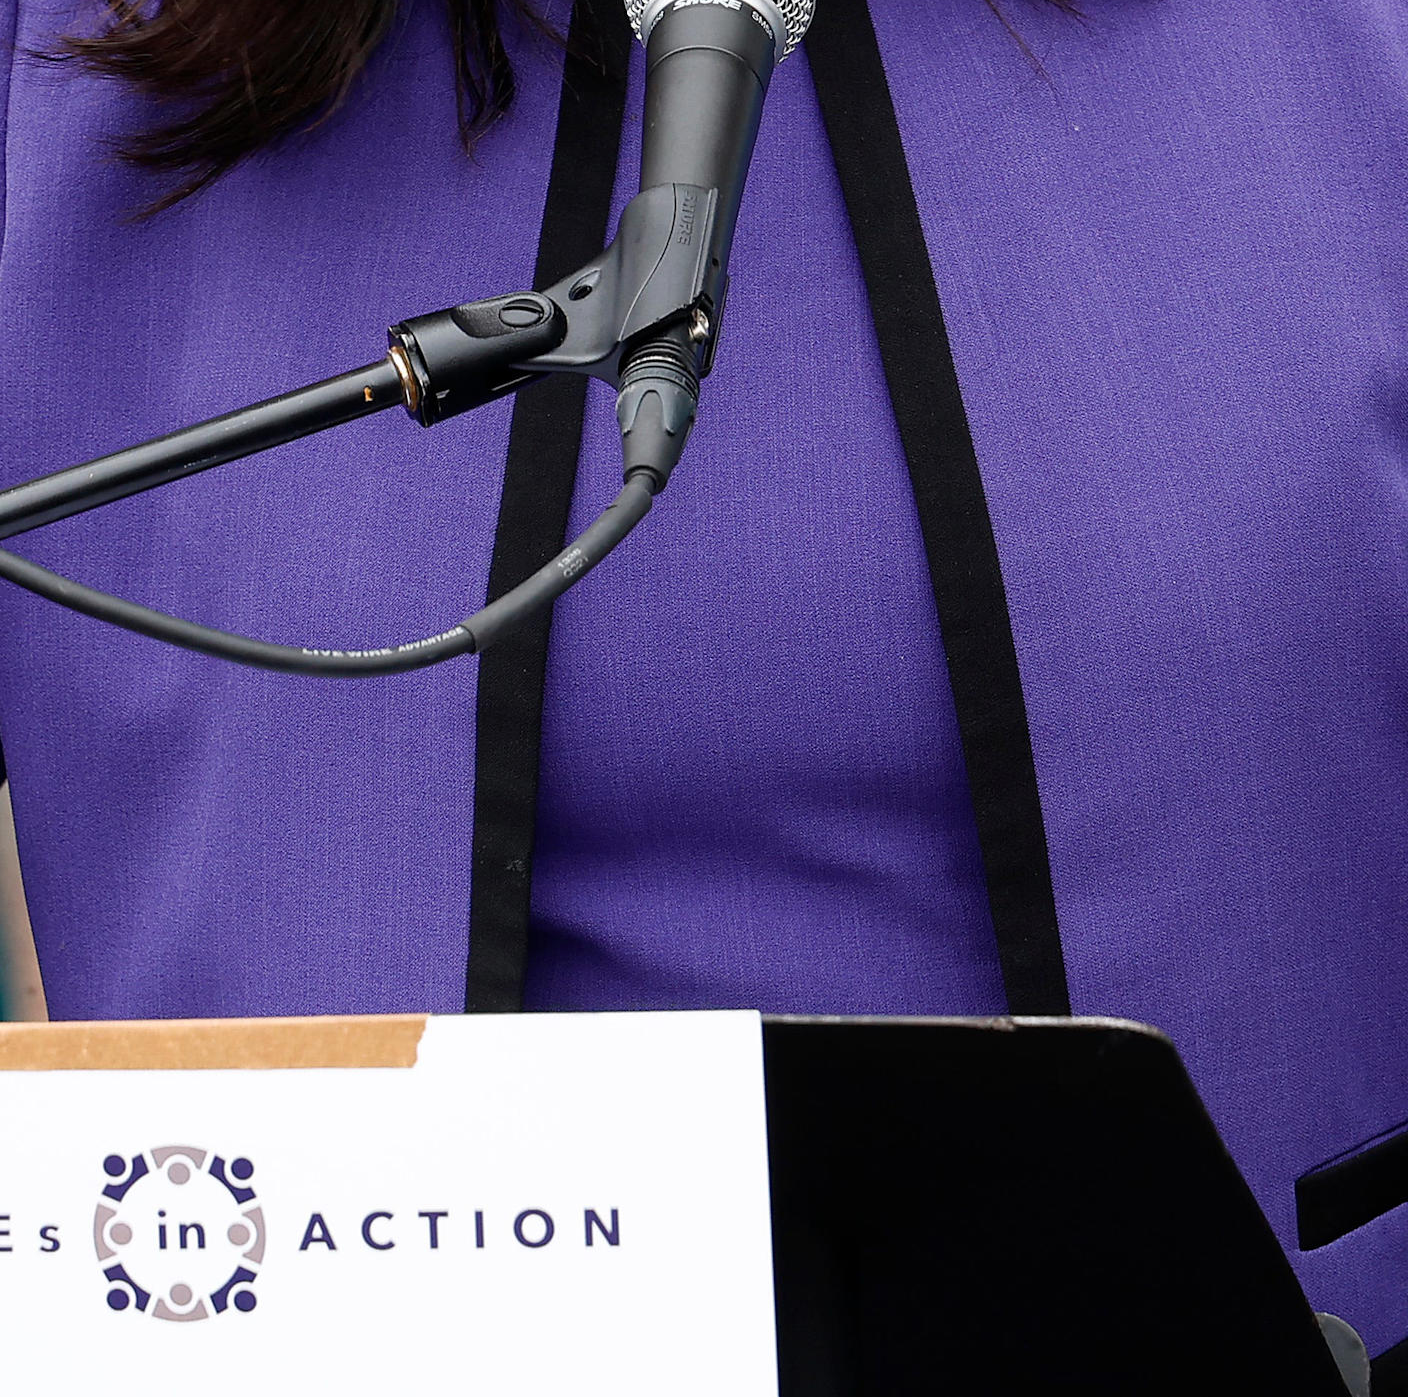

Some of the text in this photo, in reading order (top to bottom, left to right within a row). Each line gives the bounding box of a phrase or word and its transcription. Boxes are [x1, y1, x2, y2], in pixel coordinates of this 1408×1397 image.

[398, 625, 465, 653] ADVANTAGE
[157, 1212, 207, 1251] in
[299, 1208, 621, 1251] ACTION
